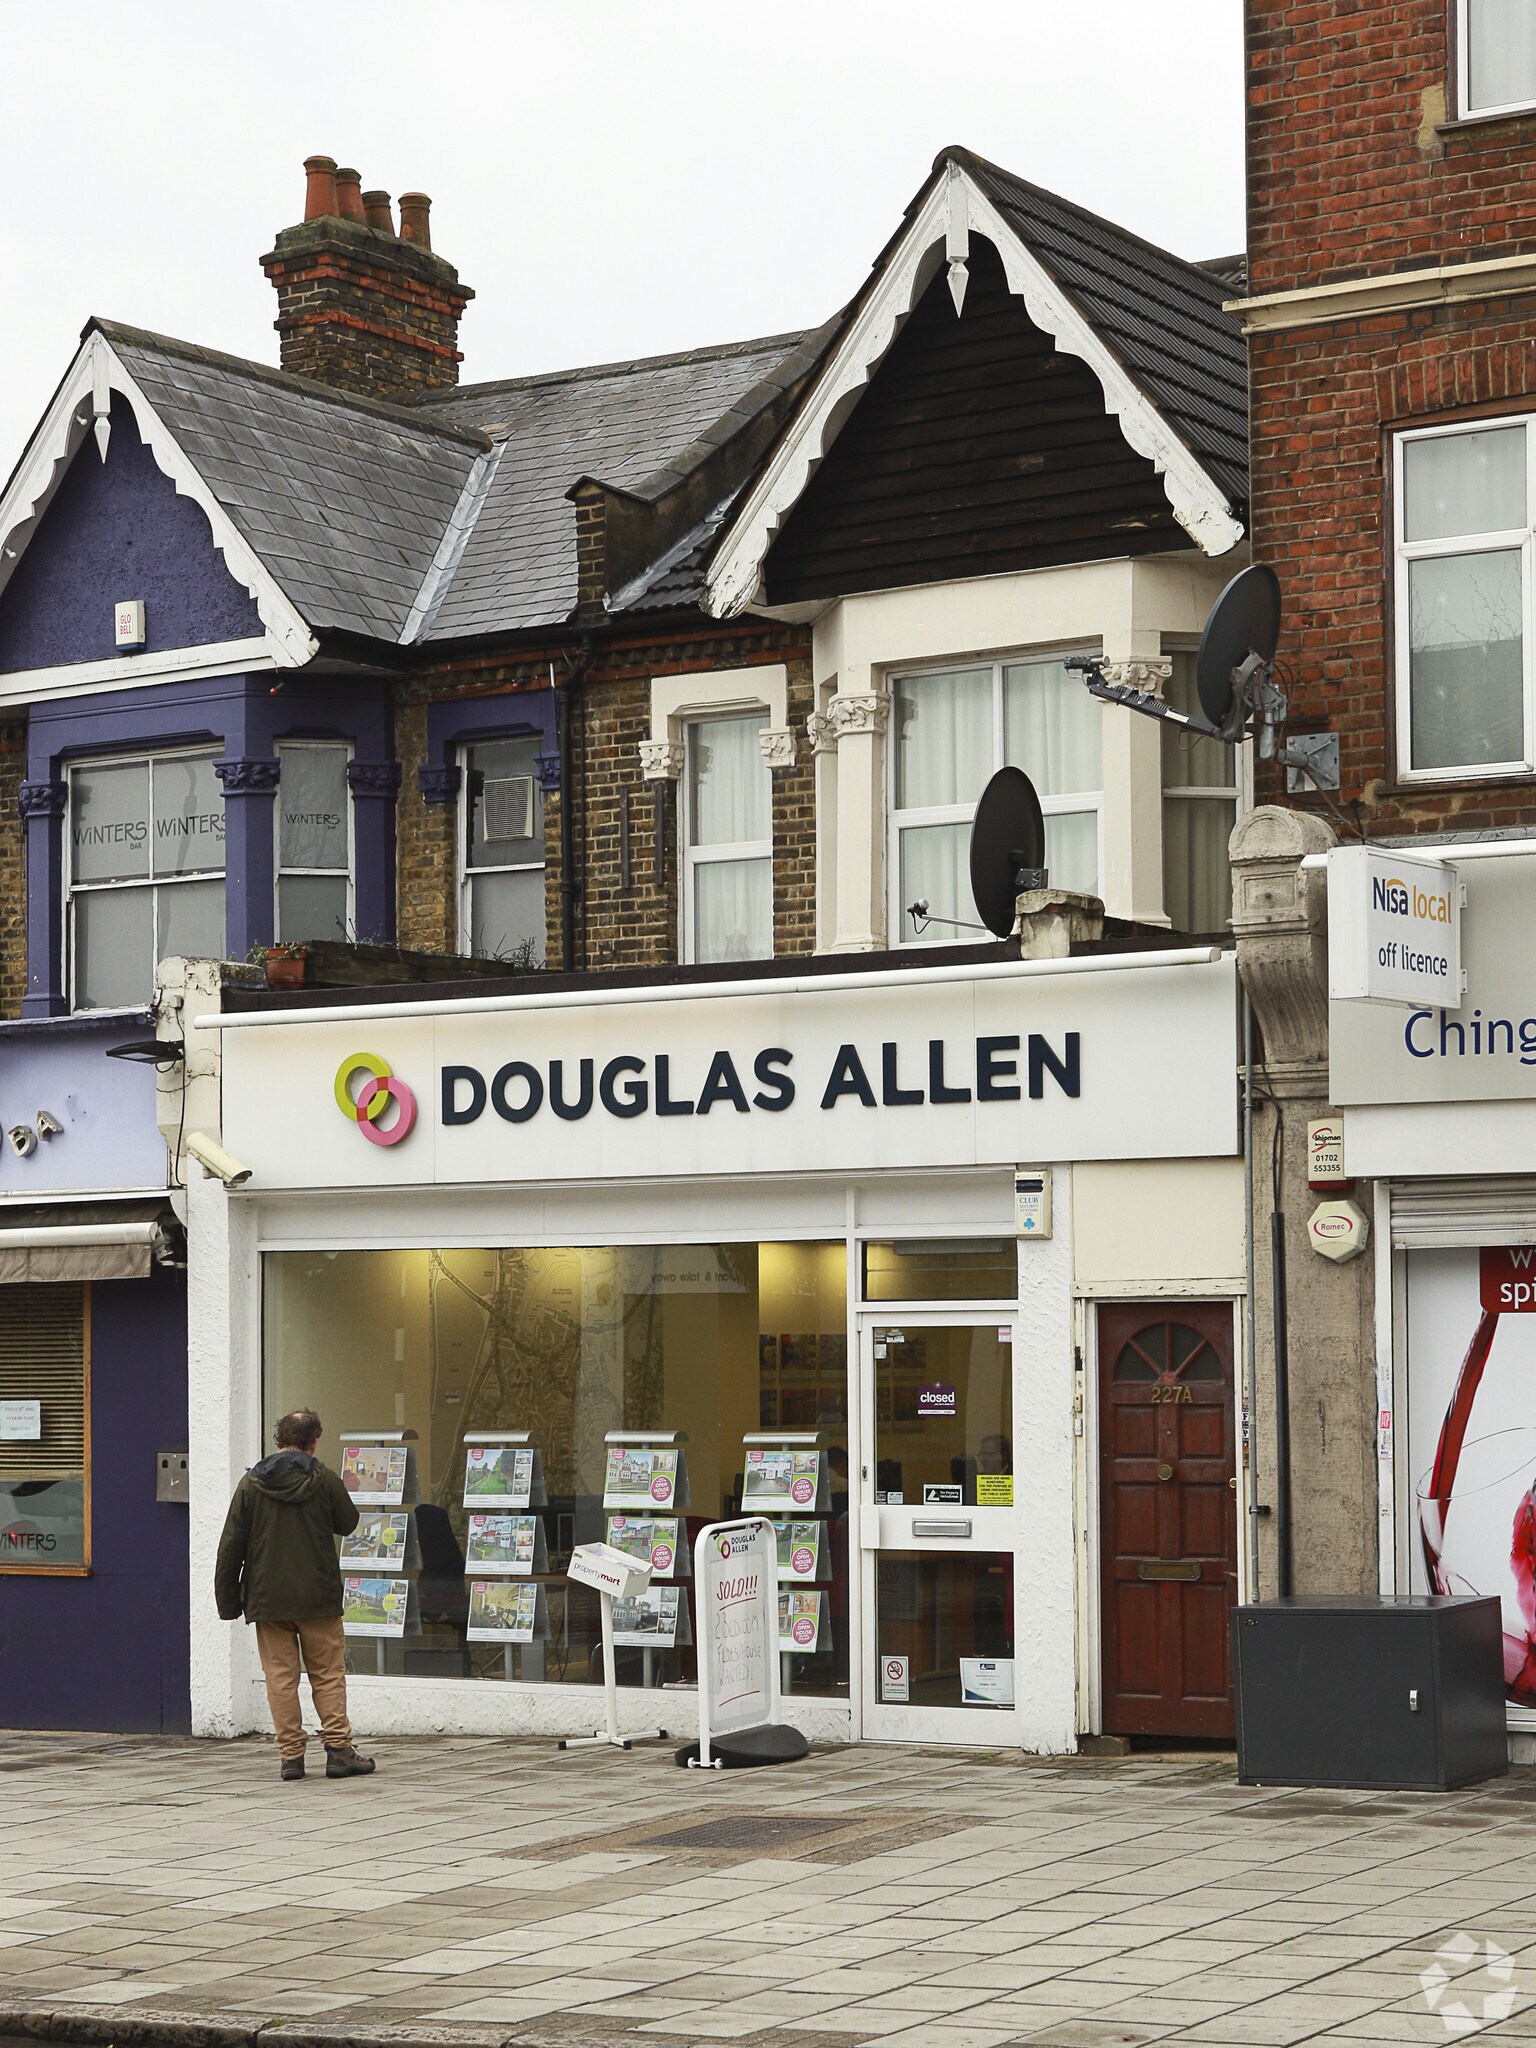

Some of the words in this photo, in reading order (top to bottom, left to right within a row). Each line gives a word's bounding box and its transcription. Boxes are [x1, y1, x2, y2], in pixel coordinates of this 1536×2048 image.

[120, 614, 131, 624] GLO
[120, 625, 132, 634] BELL
[1373, 877, 1408, 916] Nisa
[1413, 884, 1452, 924] local
[1378, 942, 1397, 970] off
[1402, 944, 1448, 976] licence
[1404, 1009, 1536, 1066] Ching
[441, 1048, 795, 1126] DOUGLAS
[820, 1031, 1081, 1110] ALLEN
[1314, 1134, 1341, 1142] Shipman
[1314, 1164, 1340, 1172] 553355
[920, 1392, 955, 1402] closed
[1152, 1386, 1193, 1403] 227A
[731, 1534, 756, 1544] DOUGLAS
[732, 1544, 749, 1553] ALLEN
[574, 1562, 620, 1585] propertymart
[716, 1575, 758, 1600] SOLD!!!
